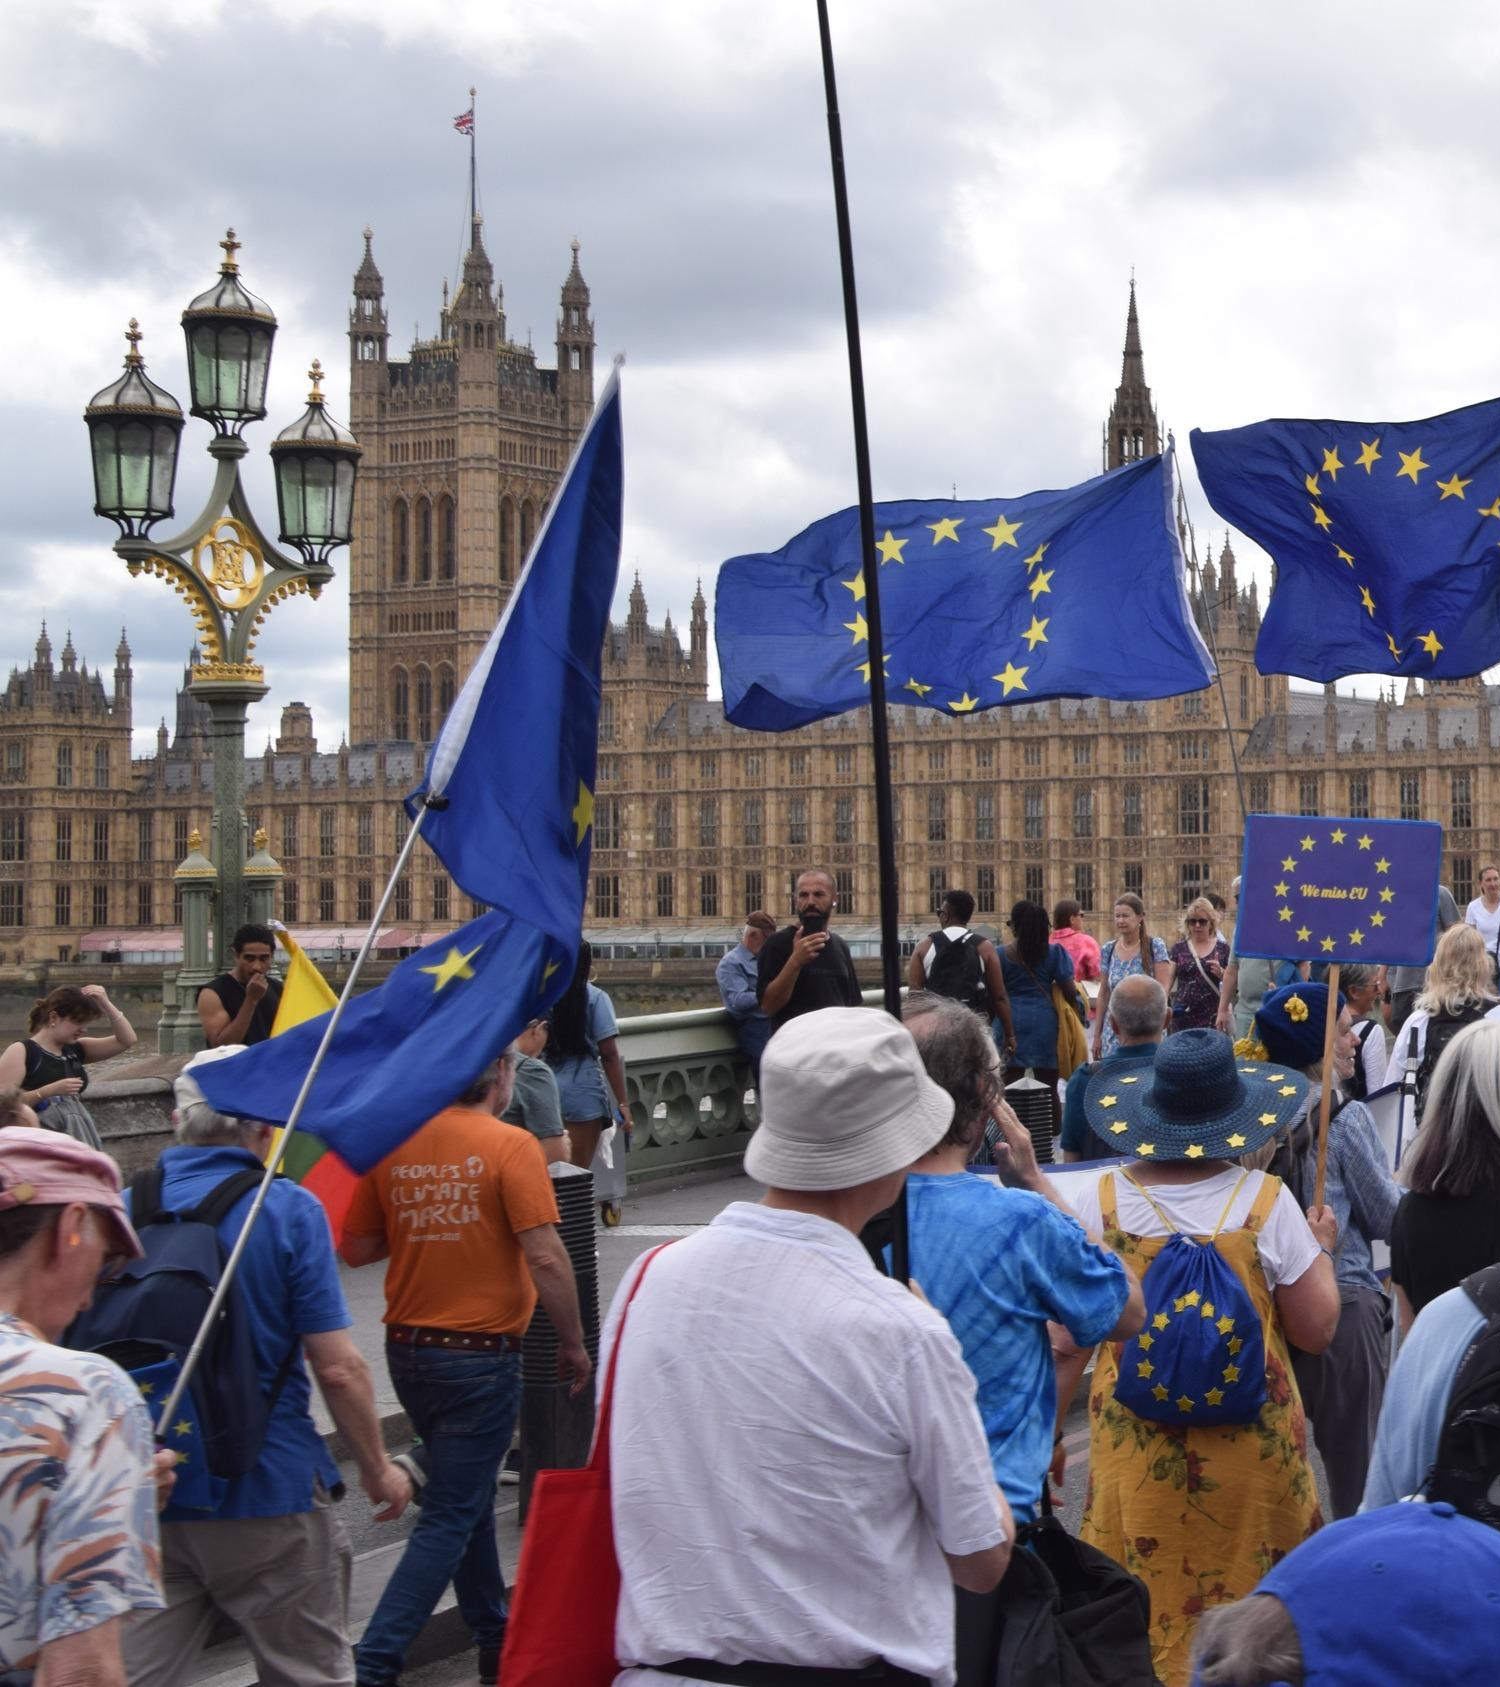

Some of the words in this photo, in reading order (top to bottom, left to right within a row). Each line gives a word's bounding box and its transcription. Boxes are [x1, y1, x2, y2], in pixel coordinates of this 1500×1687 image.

[1300, 884, 1320, 898] We
[1321, 886, 1348, 899] miss
[1349, 887, 1369, 900] EU
[398, 1203, 480, 1229] MARCH
